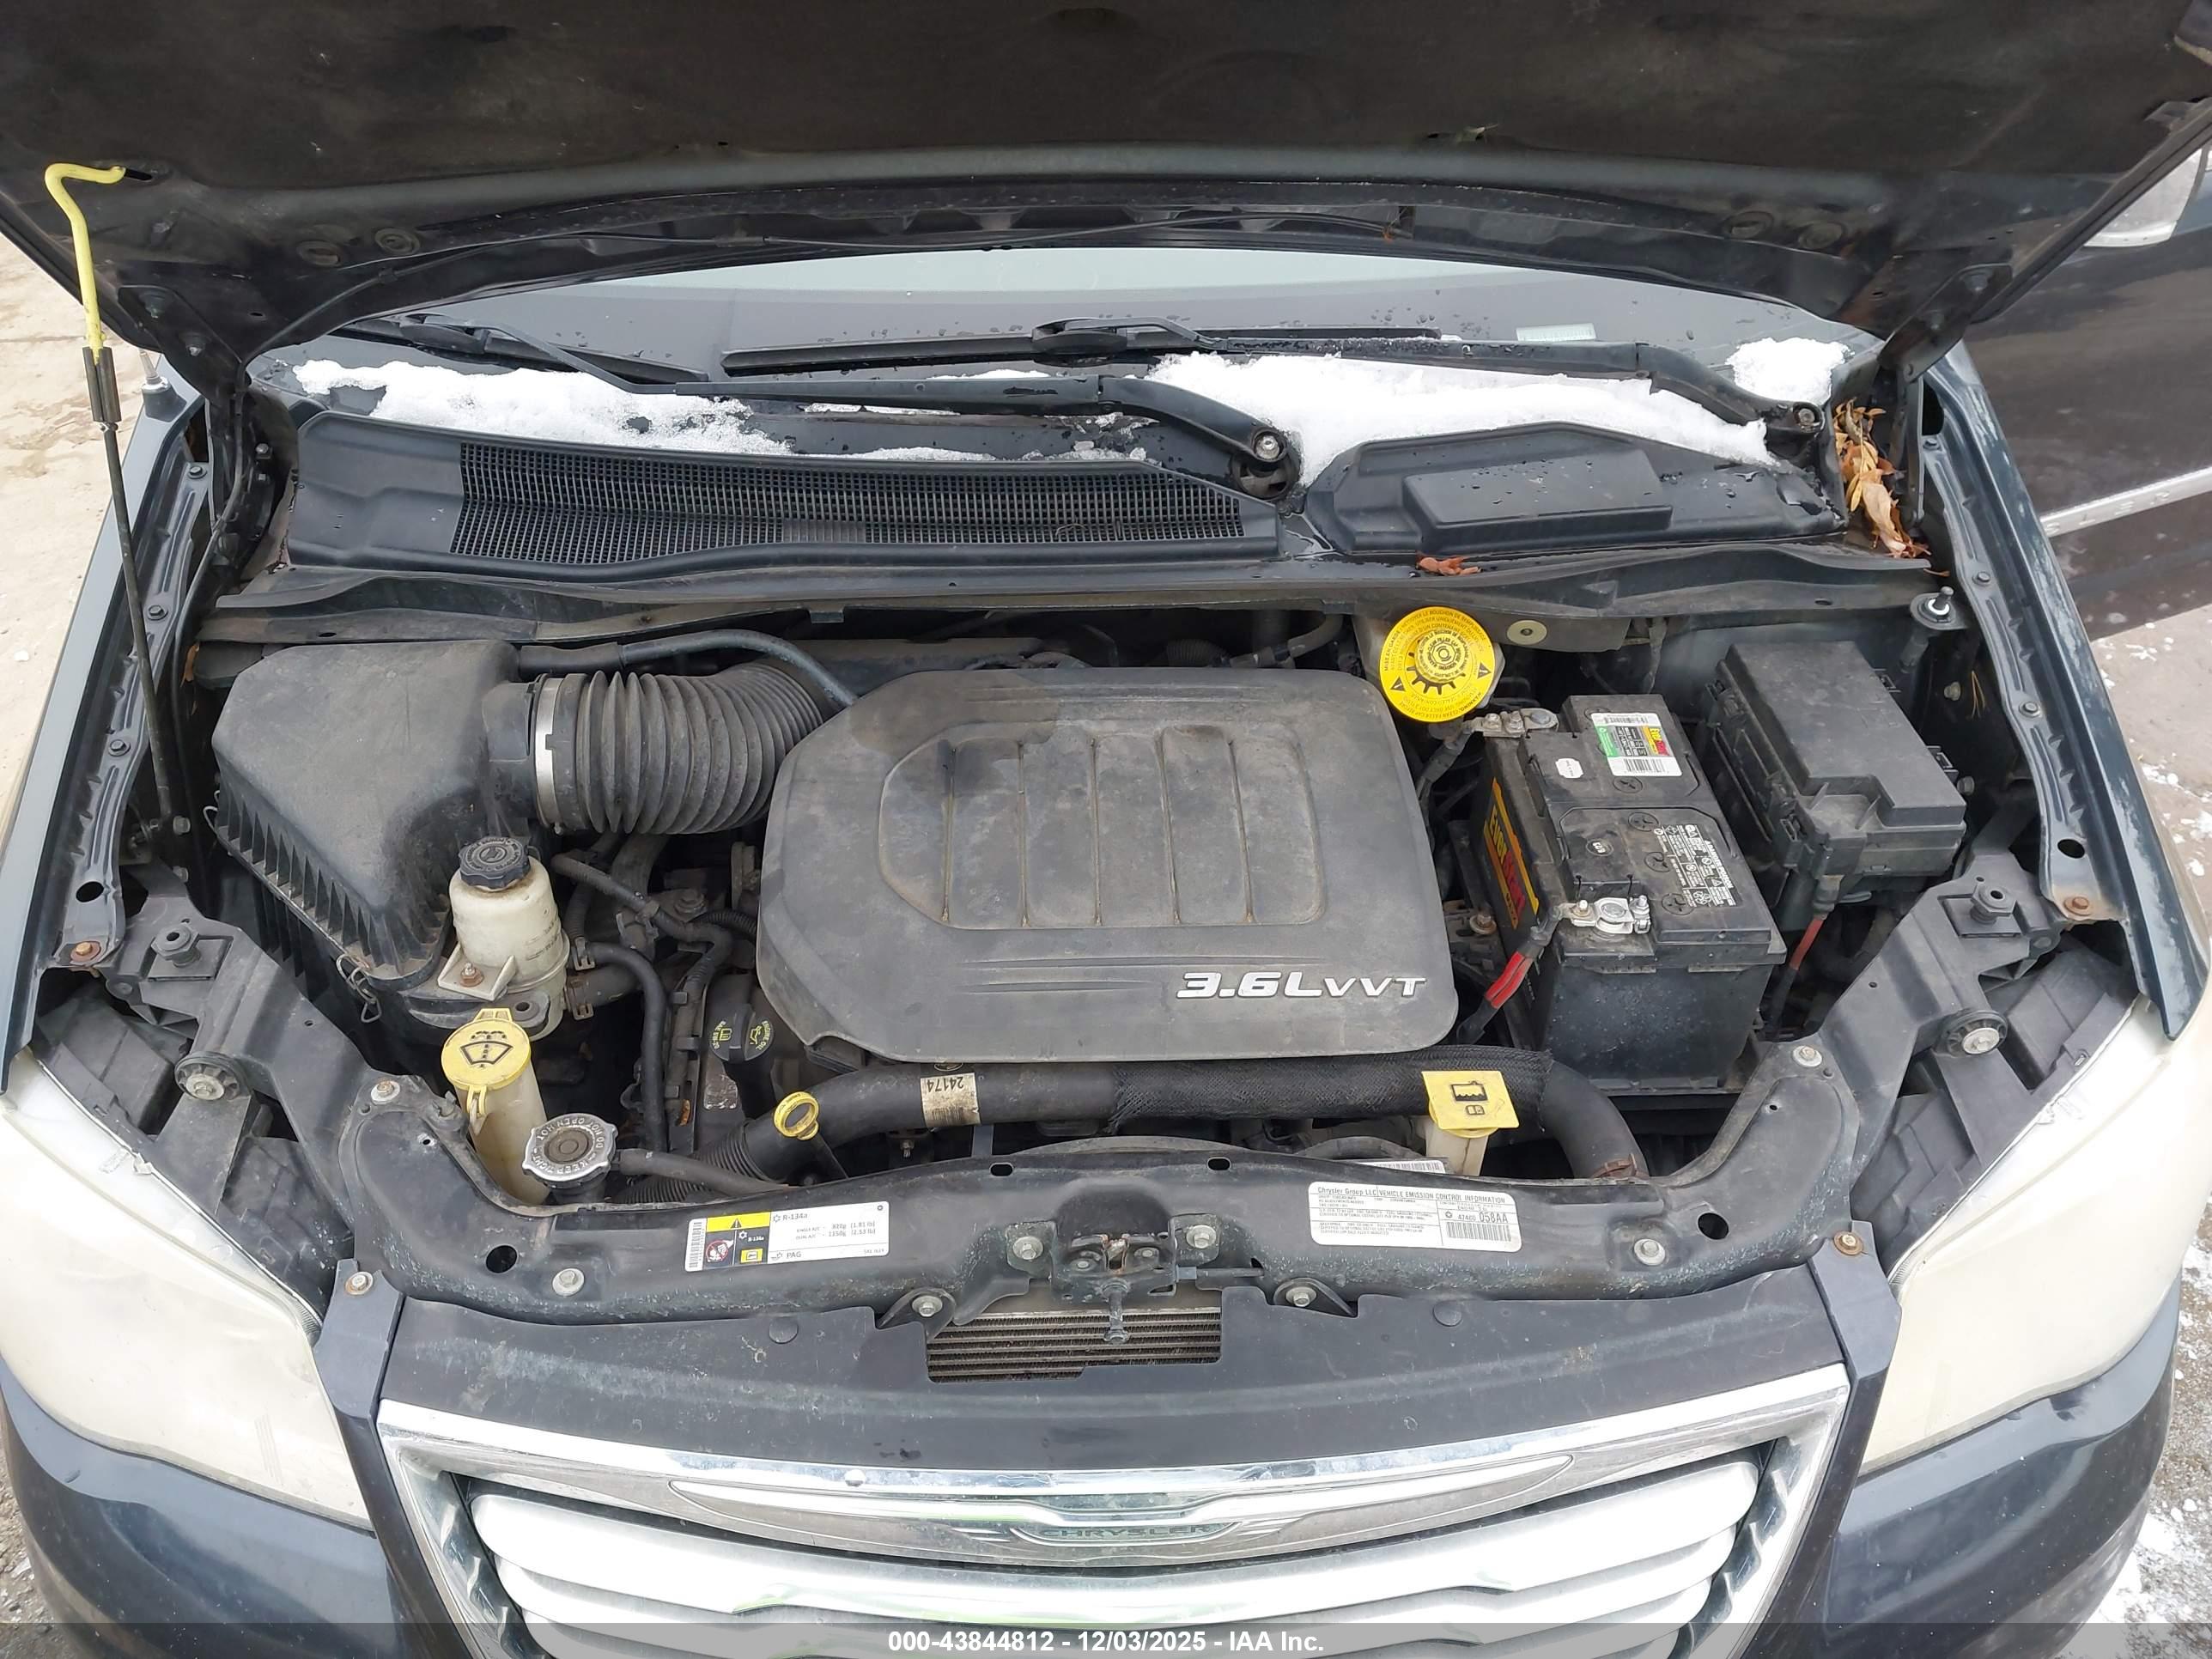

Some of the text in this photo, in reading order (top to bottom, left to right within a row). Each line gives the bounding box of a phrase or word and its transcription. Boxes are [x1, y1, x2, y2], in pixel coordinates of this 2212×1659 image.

[1176, 972, 1426, 999] 3.6L VVT
[756, 1041, 767, 1050] OIL
[927, 1076, 964, 1093] 24174
[536, 1117, 605, 1149] DO NOT OPEN HOT
[532, 1152, 589, 1175] KEEP TIGHT
[1317, 1187, 1343, 1195] Chrysler
[1345, 1188, 1364, 1196] Group
[1378, 1189, 1404, 1198] VEHICLE
[1405, 1190, 1434, 1200] EMISSION
[1435, 1193, 1462, 1202] CONTROL
[1464, 1194, 1505, 1205] INFORMATION
[782, 1212, 809, 1221] R-134a
[1479, 1212, 1509, 1224] 058AA
[1039, 1525, 1211, 1538] CHRYSLER
